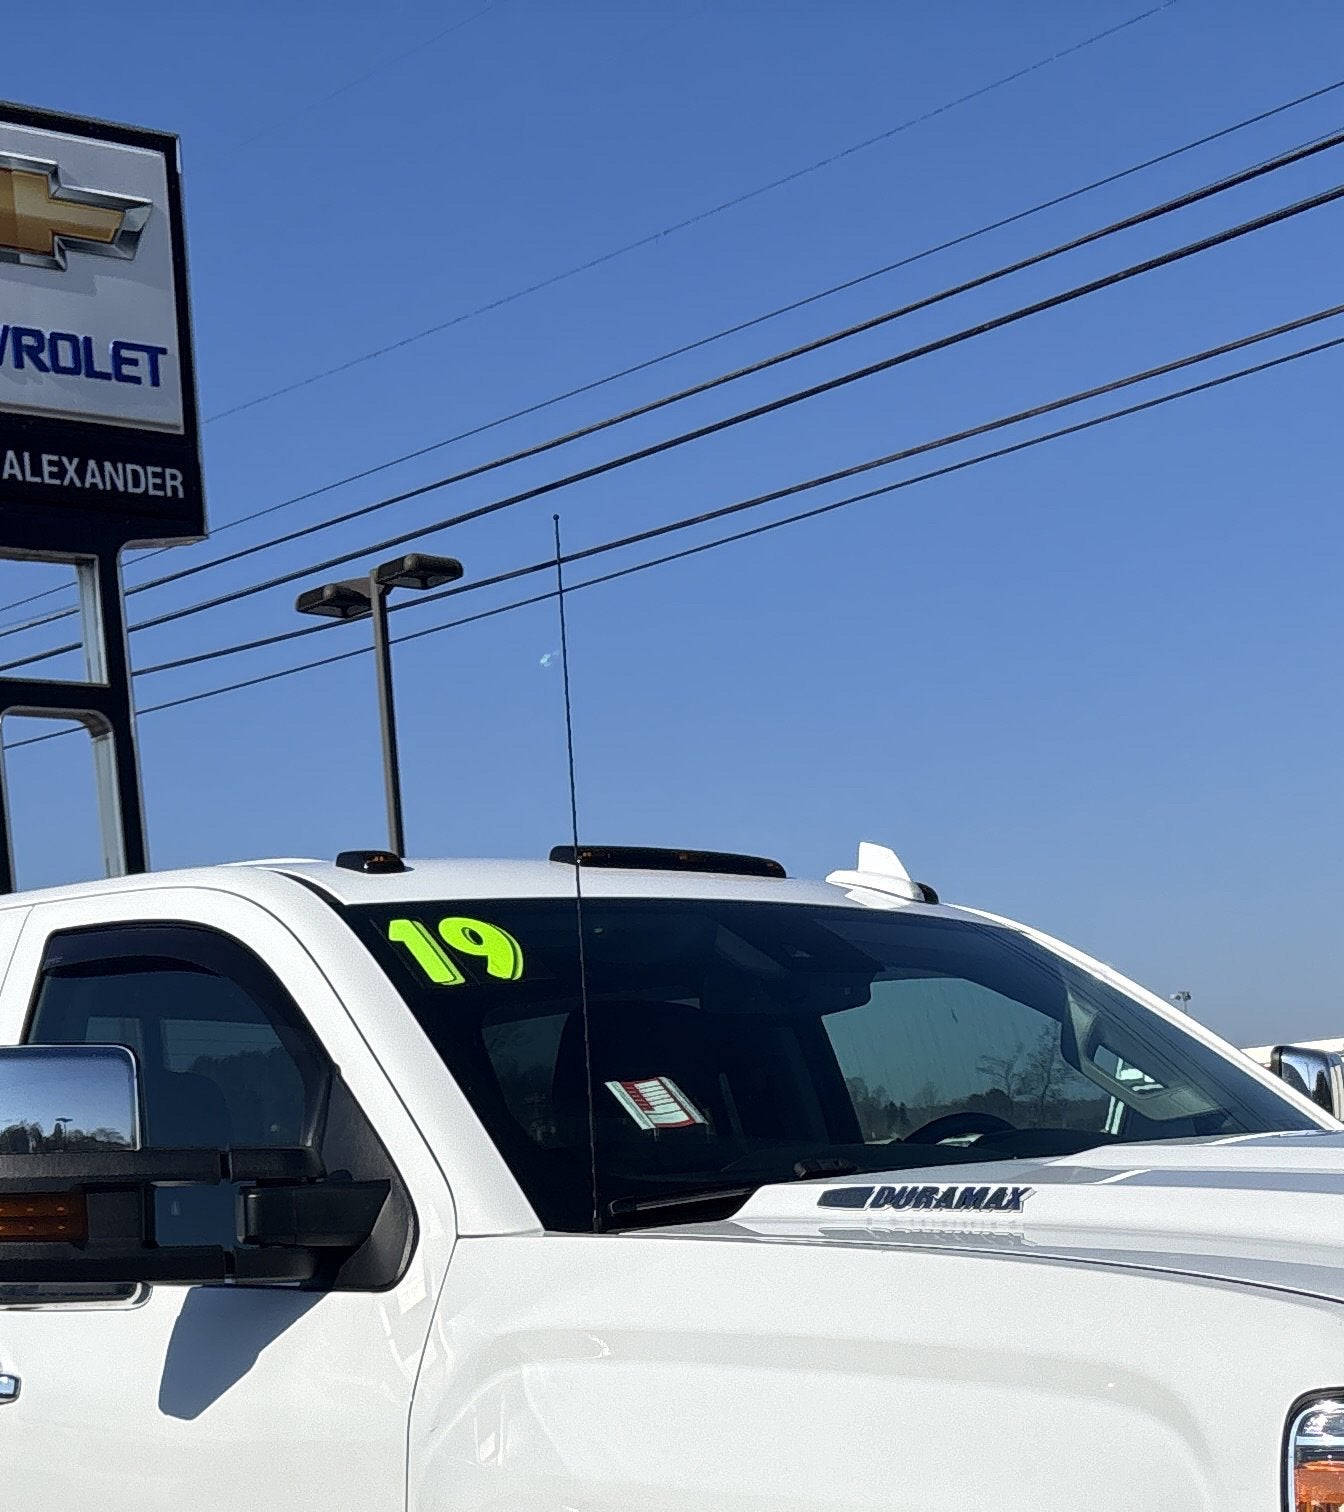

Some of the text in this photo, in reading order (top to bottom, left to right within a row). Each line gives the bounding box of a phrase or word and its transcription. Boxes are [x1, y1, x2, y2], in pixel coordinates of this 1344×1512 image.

[1, 448, 185, 500] ALEXANDER
[388, 916, 525, 986] 19
[867, 1185, 1036, 1213] DURAMAX
